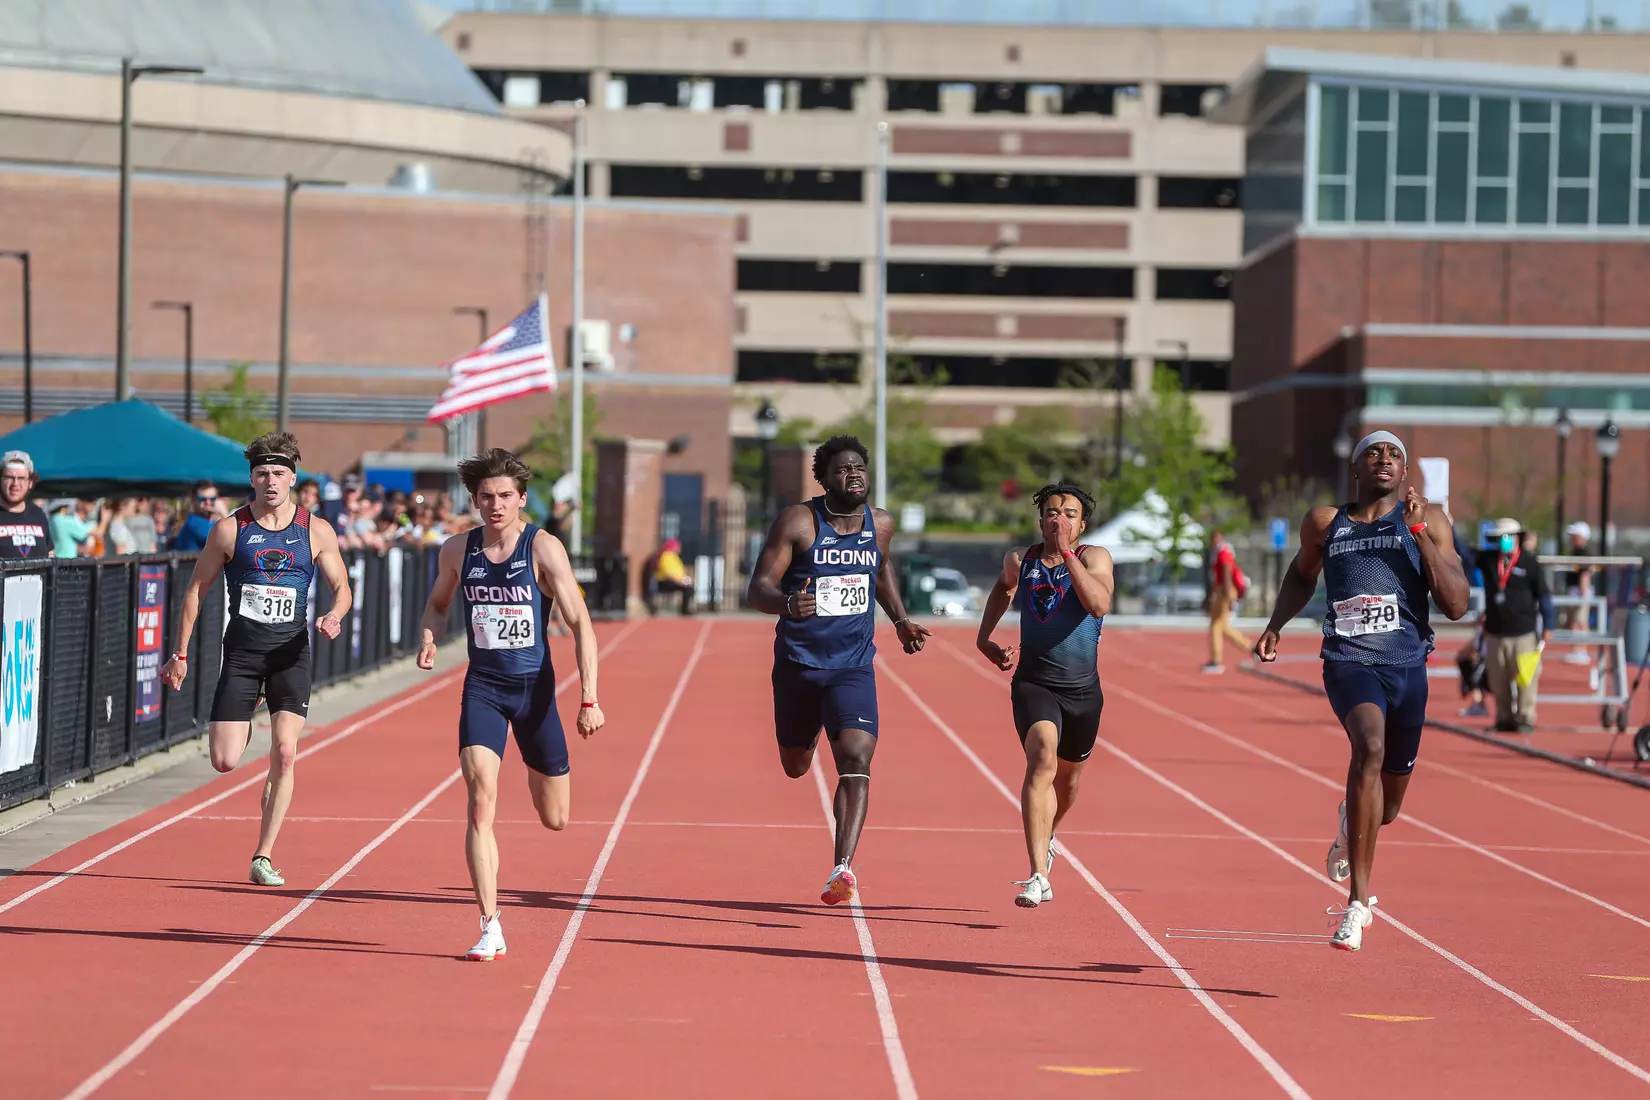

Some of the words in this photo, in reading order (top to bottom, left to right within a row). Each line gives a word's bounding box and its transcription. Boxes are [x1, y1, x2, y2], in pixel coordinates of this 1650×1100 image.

[12, 535, 37, 546] BIG
[814, 549, 877, 567] UCONN
[266, 588, 288, 596] Stanley
[463, 585, 533, 602] UCONN
[841, 587, 866, 607] 230
[1362, 596, 1383, 604] Paige
[263, 598, 292, 617] 318
[499, 608, 523, 616] O'Brien
[497, 619, 531, 640] 243
